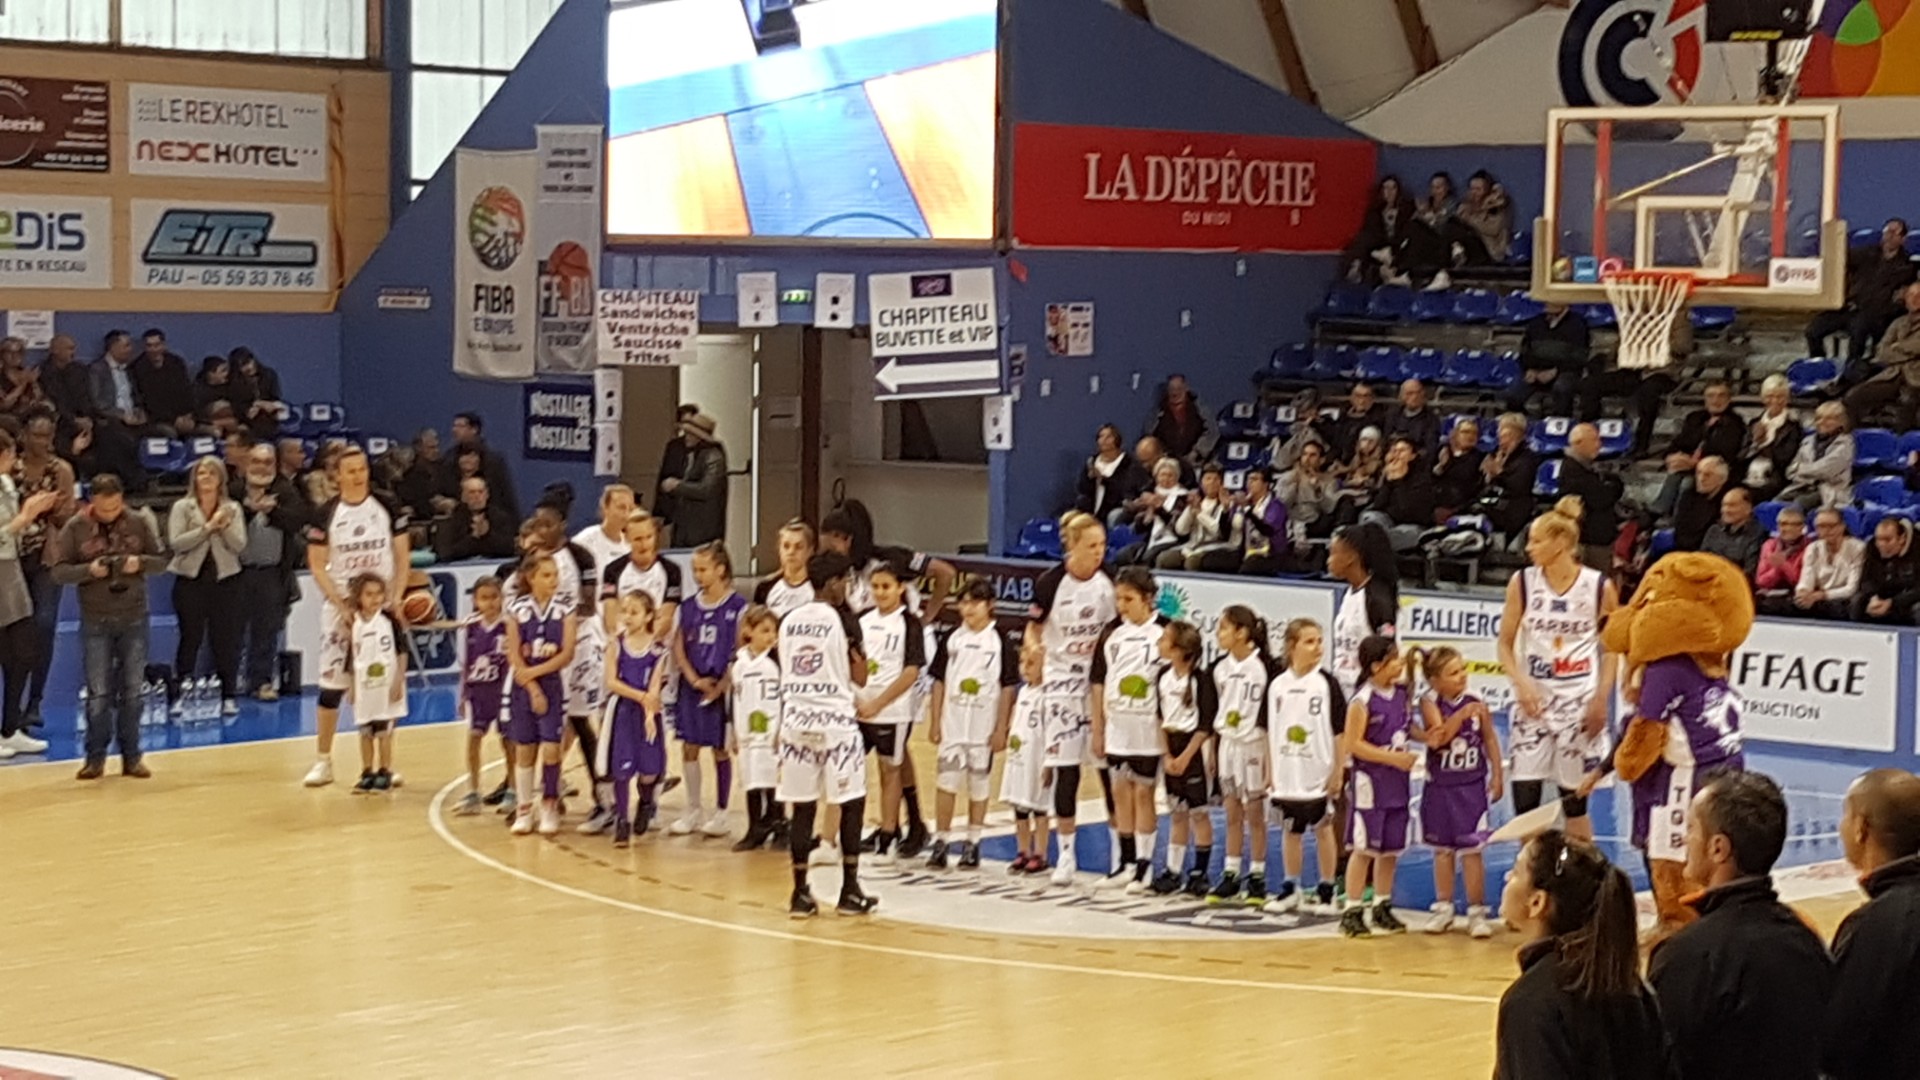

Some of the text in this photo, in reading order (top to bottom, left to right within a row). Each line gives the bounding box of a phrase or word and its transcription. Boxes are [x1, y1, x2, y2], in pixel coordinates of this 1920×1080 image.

[1084, 145, 1316, 206] LA DÉPÊCHE
[148, 269, 184, 285] PAU
[201, 270, 221, 286] 05
[225, 271, 245, 286] 59
[473, 284, 515, 314] FIBA
[601, 291, 695, 305] CHAPITEAU
[600, 305, 695, 319] Sandwiches
[879, 303, 988, 327] CHAPITEAU
[613, 335, 682, 349] Saucisse
[876, 325, 993, 347] BUVETTE et VIP
[625, 351, 670, 363] Frites
[884, 633, 900, 651] 11
[985, 651, 996, 669] 7
[1737, 652, 1869, 696] FFAGE
[1243, 682, 1261, 702] 10
[1308, 696, 1322, 716] 8
[1441, 750, 1479, 769] TGB
